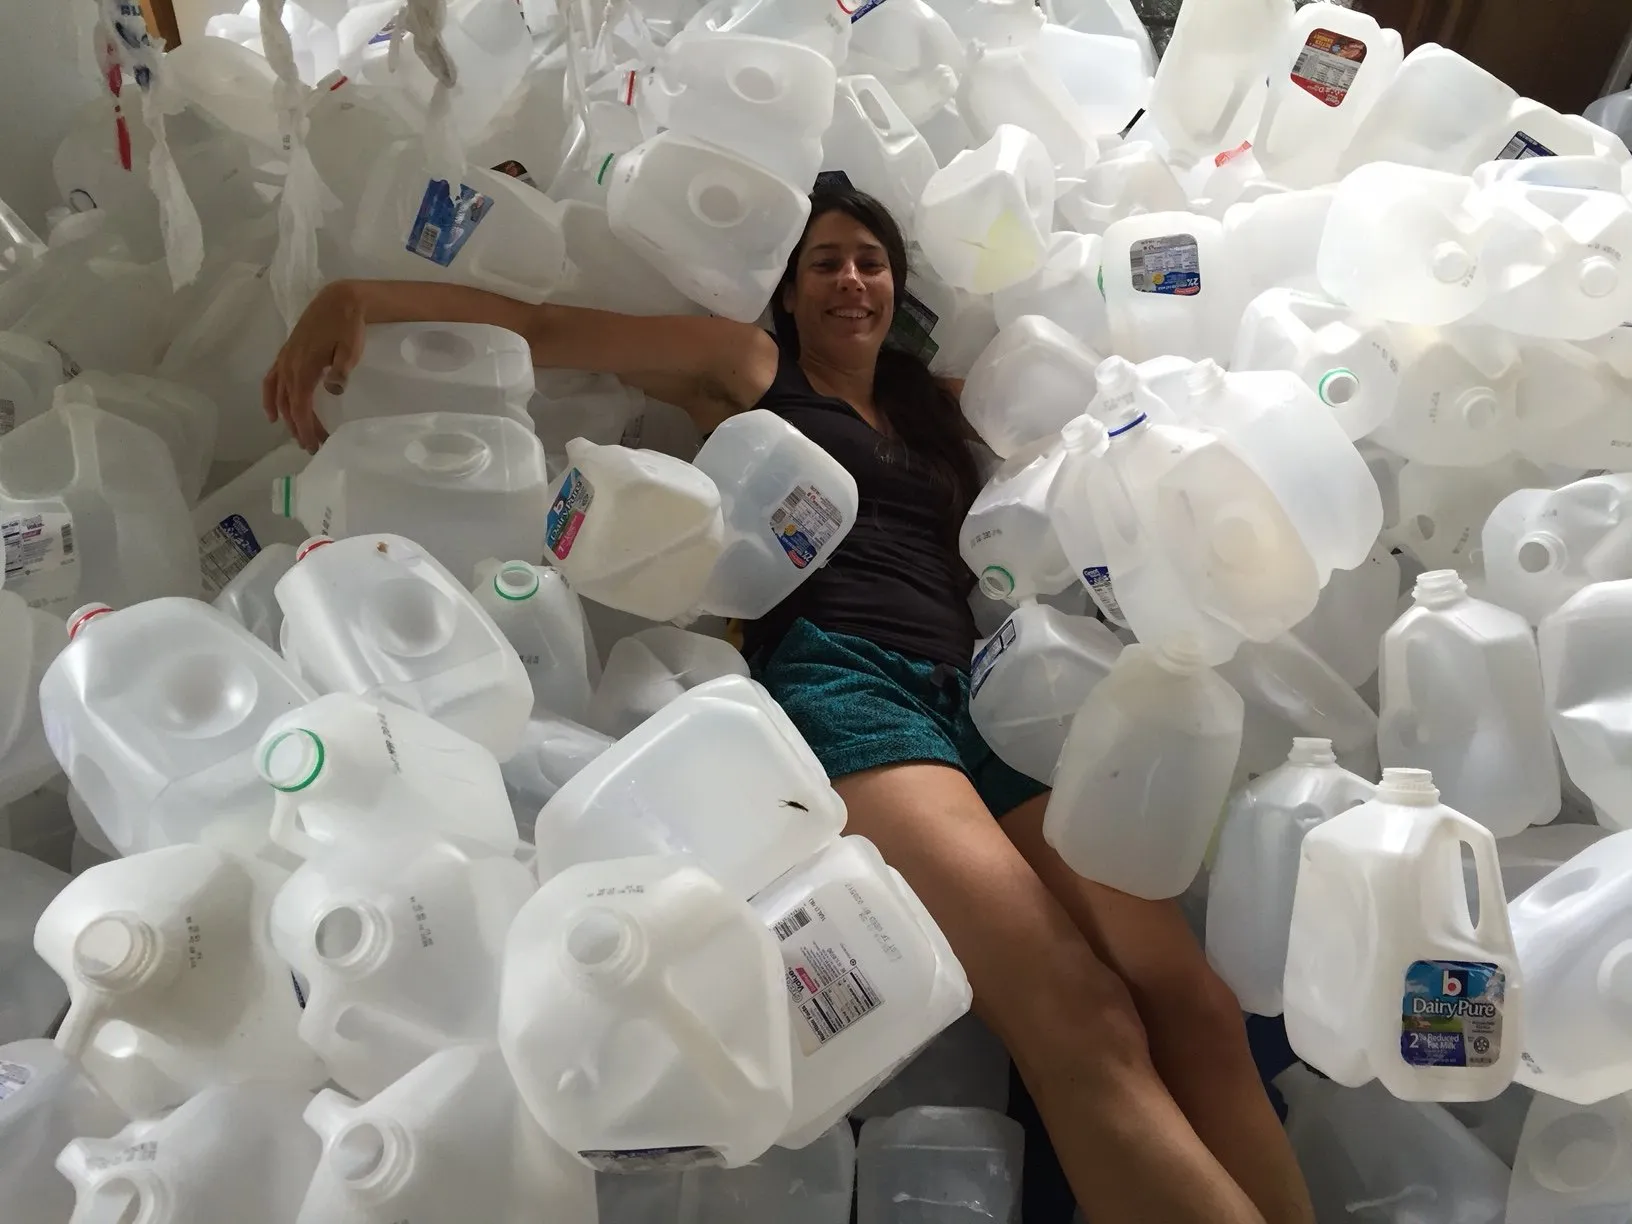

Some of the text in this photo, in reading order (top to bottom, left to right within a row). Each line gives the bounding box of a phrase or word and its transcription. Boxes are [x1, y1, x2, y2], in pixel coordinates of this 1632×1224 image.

[1186, 277, 1199, 287] 2%
[1442, 969, 1462, 996] b
[801, 1005, 812, 1018] Facts
[1413, 998, 1496, 1018] DairyPure
[811, 1017, 826, 1042] Nutrition
[1427, 1033, 1460, 1042] Reduced
[1427, 1040, 1457, 1050] Fat Milk
